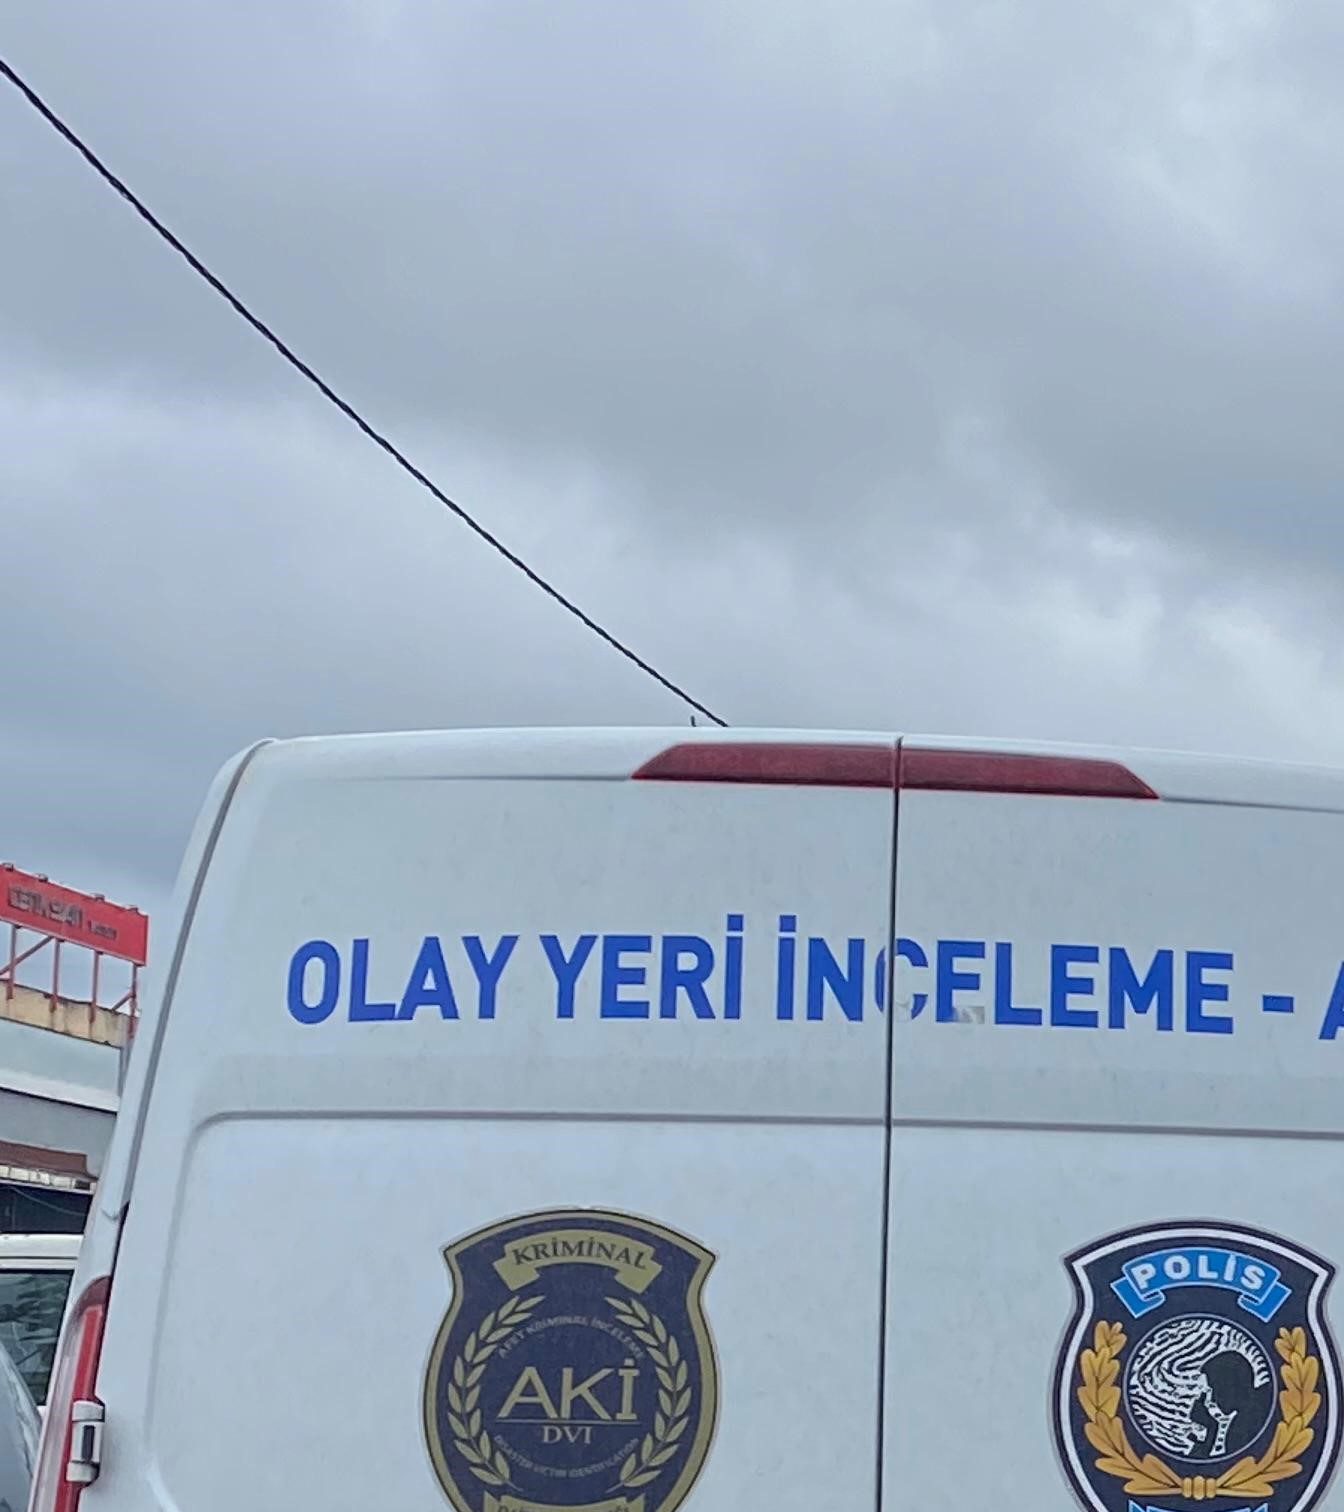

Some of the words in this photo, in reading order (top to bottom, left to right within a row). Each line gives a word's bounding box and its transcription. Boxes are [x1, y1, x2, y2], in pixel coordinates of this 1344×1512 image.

[286, 935, 519, 1025] OLAY
[539, 913, 744, 1020] YERİ
[777, 914, 1234, 1035] İNCELEME
[512, 1236, 647, 1270] KRİMİNAL
[1131, 1253, 1265, 1290] POLİS
[496, 1358, 642, 1421] AKİ
[541, 1425, 593, 1444] DVI
